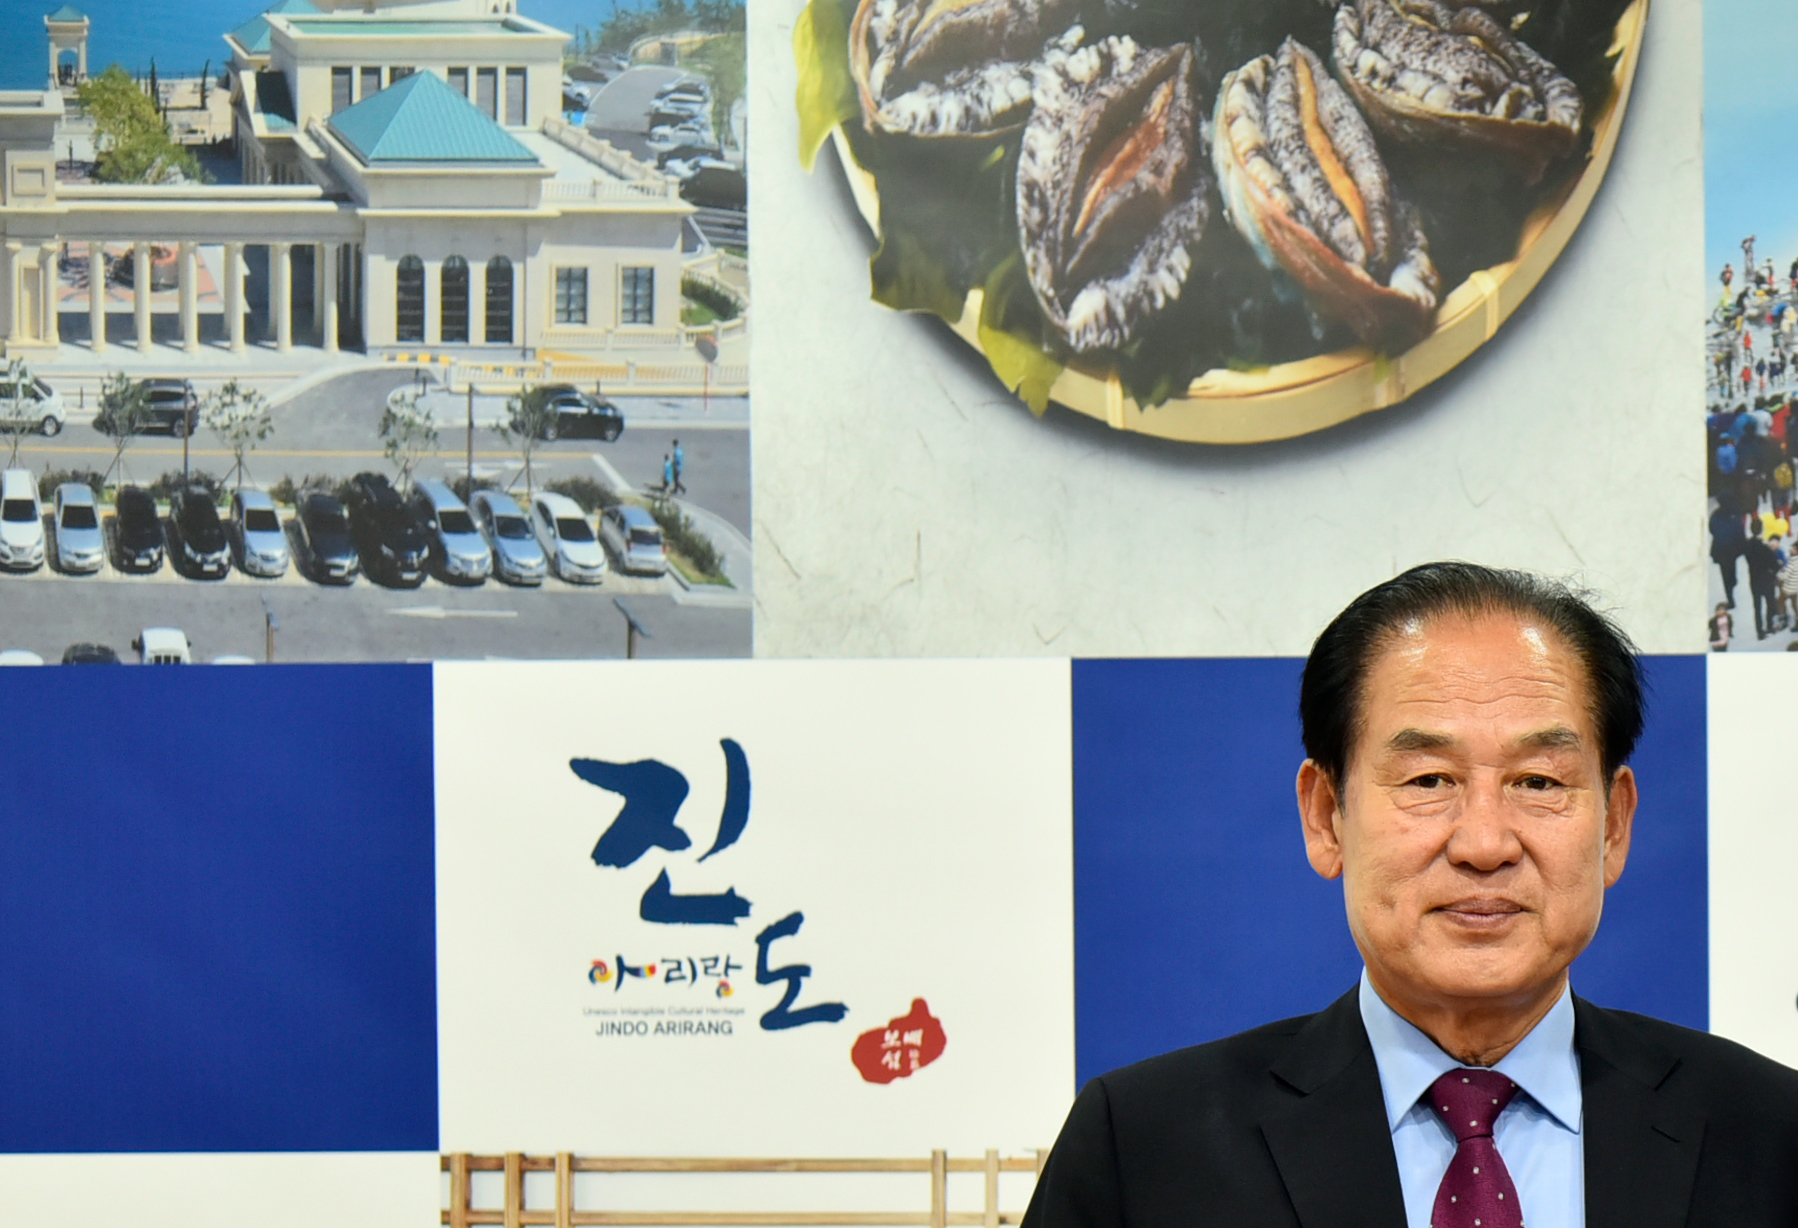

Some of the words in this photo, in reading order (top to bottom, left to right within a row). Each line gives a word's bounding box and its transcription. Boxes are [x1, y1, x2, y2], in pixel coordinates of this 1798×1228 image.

[588, 953, 743, 999] 아리랑
[595, 1020, 649, 1037] JINDO
[653, 1020, 734, 1037] ARIRANG
